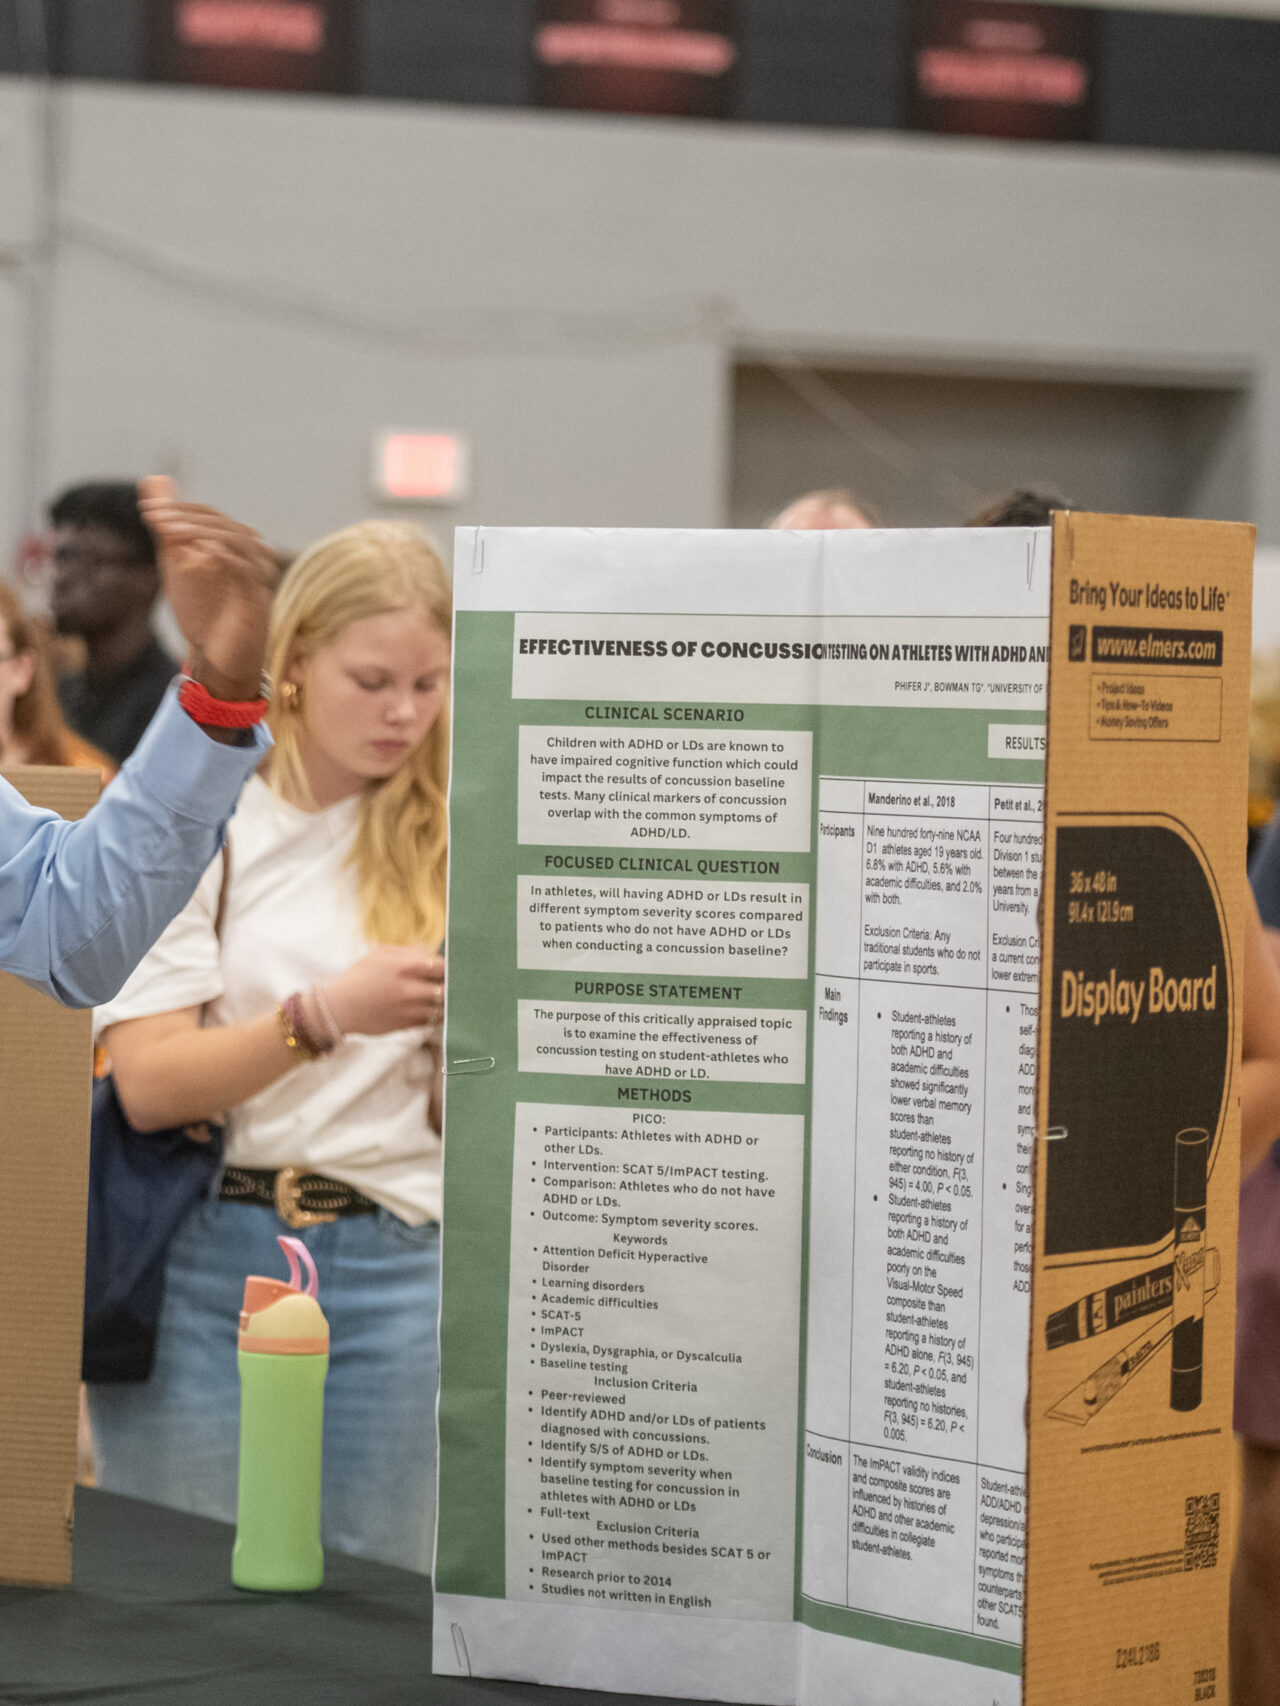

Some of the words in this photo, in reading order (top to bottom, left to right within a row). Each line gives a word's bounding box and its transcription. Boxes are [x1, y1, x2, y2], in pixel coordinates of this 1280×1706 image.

[1069, 578, 1107, 611] Bring
[1109, 581, 1144, 607] Your
[1146, 583, 1183, 610] Ideas
[1185, 586, 1198, 610] to
[519, 639, 668, 657] EFFECTIVENESS
[671, 641, 697, 657] OF
[828, 644, 867, 660] TESTING
[869, 644, 889, 660] ON
[891, 644, 952, 662] ATHLETES
[955, 645, 989, 662] WITH
[991, 646, 1027, 662] ADHD
[1097, 634, 1216, 659] www.elmers.com
[894, 681, 922, 691] PHIFER
[934, 682, 969, 693] BOWMAN
[1033, 683, 1044, 693] OF
[585, 706, 659, 720] CLINICAL
[663, 707, 744, 722] SCENARIO
[547, 737, 597, 748] Children
[599, 738, 625, 748] with
[628, 739, 663, 749] ADHD
[666, 742, 679, 750] or
[682, 740, 704, 750] LDs
[707, 743, 726, 751] are
[729, 741, 768, 752] known
[771, 743, 784, 752] to
[1006, 736, 1045, 750] RESULTS
[531, 754, 558, 765] have
[561, 755, 612, 768] impaired
[615, 756, 670, 769] cognitive
[672, 757, 723, 768] function
[726, 759, 761, 769] which
[764, 760, 798, 770] could
[542, 772, 582, 785] impact
[585, 773, 604, 784] the
[607, 774, 647, 784] results
[650, 774, 662, 785] of
[665, 776, 731, 786] concussion
[735, 776, 785, 788] baseline
[539, 791, 570, 800] tests.
[574, 790, 605, 804] Many
[608, 791, 650, 802] clinical
[653, 793, 701, 803] markers
[704, 793, 717, 804] of
[719, 795, 787, 805] concussion
[868, 792, 912, 806] Manderino
[913, 796, 921, 806] et
[923, 795, 934, 808] al.,
[936, 795, 955, 807] 2018
[548, 808, 591, 821] overlap
[594, 808, 619, 819] with
[623, 809, 642, 820] the
[645, 812, 696, 821] common
[699, 813, 762, 824] symptoms
[765, 812, 778, 823] of
[630, 827, 690, 839] ADHD/LD.
[545, 855, 614, 869] FOCUSED
[619, 857, 693, 872] CLINICAL
[697, 860, 779, 875] QUESTION
[1069, 871, 1084, 894] 36
[1084, 877, 1092, 893] x
[1092, 870, 1106, 893] 48
[1106, 872, 1118, 893] in
[531, 886, 542, 895] In
[545, 886, 596, 899] athletes,
[600, 888, 620, 898] will
[623, 888, 663, 902] having
[666, 890, 703, 900] ADHD
[707, 893, 720, 901] or
[724, 891, 747, 902] LDs
[750, 892, 787, 903] result
[791, 893, 802, 903] in
[529, 903, 580, 914] different
[584, 906, 639, 918] symptom
[643, 907, 692, 921] severity
[695, 910, 736, 919] scores
[739, 911, 803, 923] compared
[540, 922, 552, 931] to
[555, 921, 603, 934] patients
[606, 923, 631, 934] who
[634, 924, 649, 934] do
[653, 926, 673, 935] not
[677, 925, 706, 936] have
[709, 926, 747, 937] ADHD
[750, 930, 764, 938] or
[768, 928, 791, 939] LDs
[542, 938, 572, 949] when
[575, 940, 643, 954] conducting
[646, 944, 652, 952] a
[656, 943, 725, 954] concussion
[729, 944, 788, 956] baseline?
[575, 981, 644, 996] PURPOSE
[649, 984, 743, 1000] STATEMENT
[825, 987, 841, 1001] Main
[1061, 969, 1145, 1025] Display
[1149, 965, 1216, 1013] Board
[534, 1009, 554, 1020] The
[556, 1012, 601, 1023] purpose
[604, 1012, 616, 1022] of
[618, 1012, 640, 1023] this
[643, 1014, 694, 1028] critically
[697, 1016, 757, 1029] appraised
[760, 1018, 792, 1031] topic
[819, 1006, 848, 1026] Findings
[892, 1010, 956, 1027] Student-athletes
[605, 1064, 633, 1075] have
[635, 1066, 671, 1077] ADHD
[674, 1069, 687, 1078] or
[690, 1068, 709, 1079] LD.
[618, 1087, 692, 1103] METHODS
[633, 1113, 665, 1124] PICO:
[545, 1125, 617, 1140] Participants:
[621, 1130, 671, 1142] Athletes
[675, 1132, 701, 1143] with
[705, 1133, 742, 1145] ADHD
[746, 1137, 759, 1145] or
[613, 1233, 668, 1246] Keywords
[542, 1277, 590, 1292] Learning
[592, 1280, 645, 1293] disorders
[1114, 1275, 1173, 1322] painters
[541, 1309, 581, 1321] SCAT-5
[594, 1376, 648, 1389] Inclusion
[652, 1379, 697, 1392] Criteria
[541, 1389, 626, 1405] Peer-reviewed
[807, 1443, 842, 1465] Conclusion
[597, 1520, 651, 1535] Exclusion
[654, 1525, 699, 1538] Criteria
[542, 1566, 594, 1580] Research
[597, 1572, 625, 1584] prior
[628, 1575, 641, 1584] to
[644, 1575, 672, 1587] 2014
